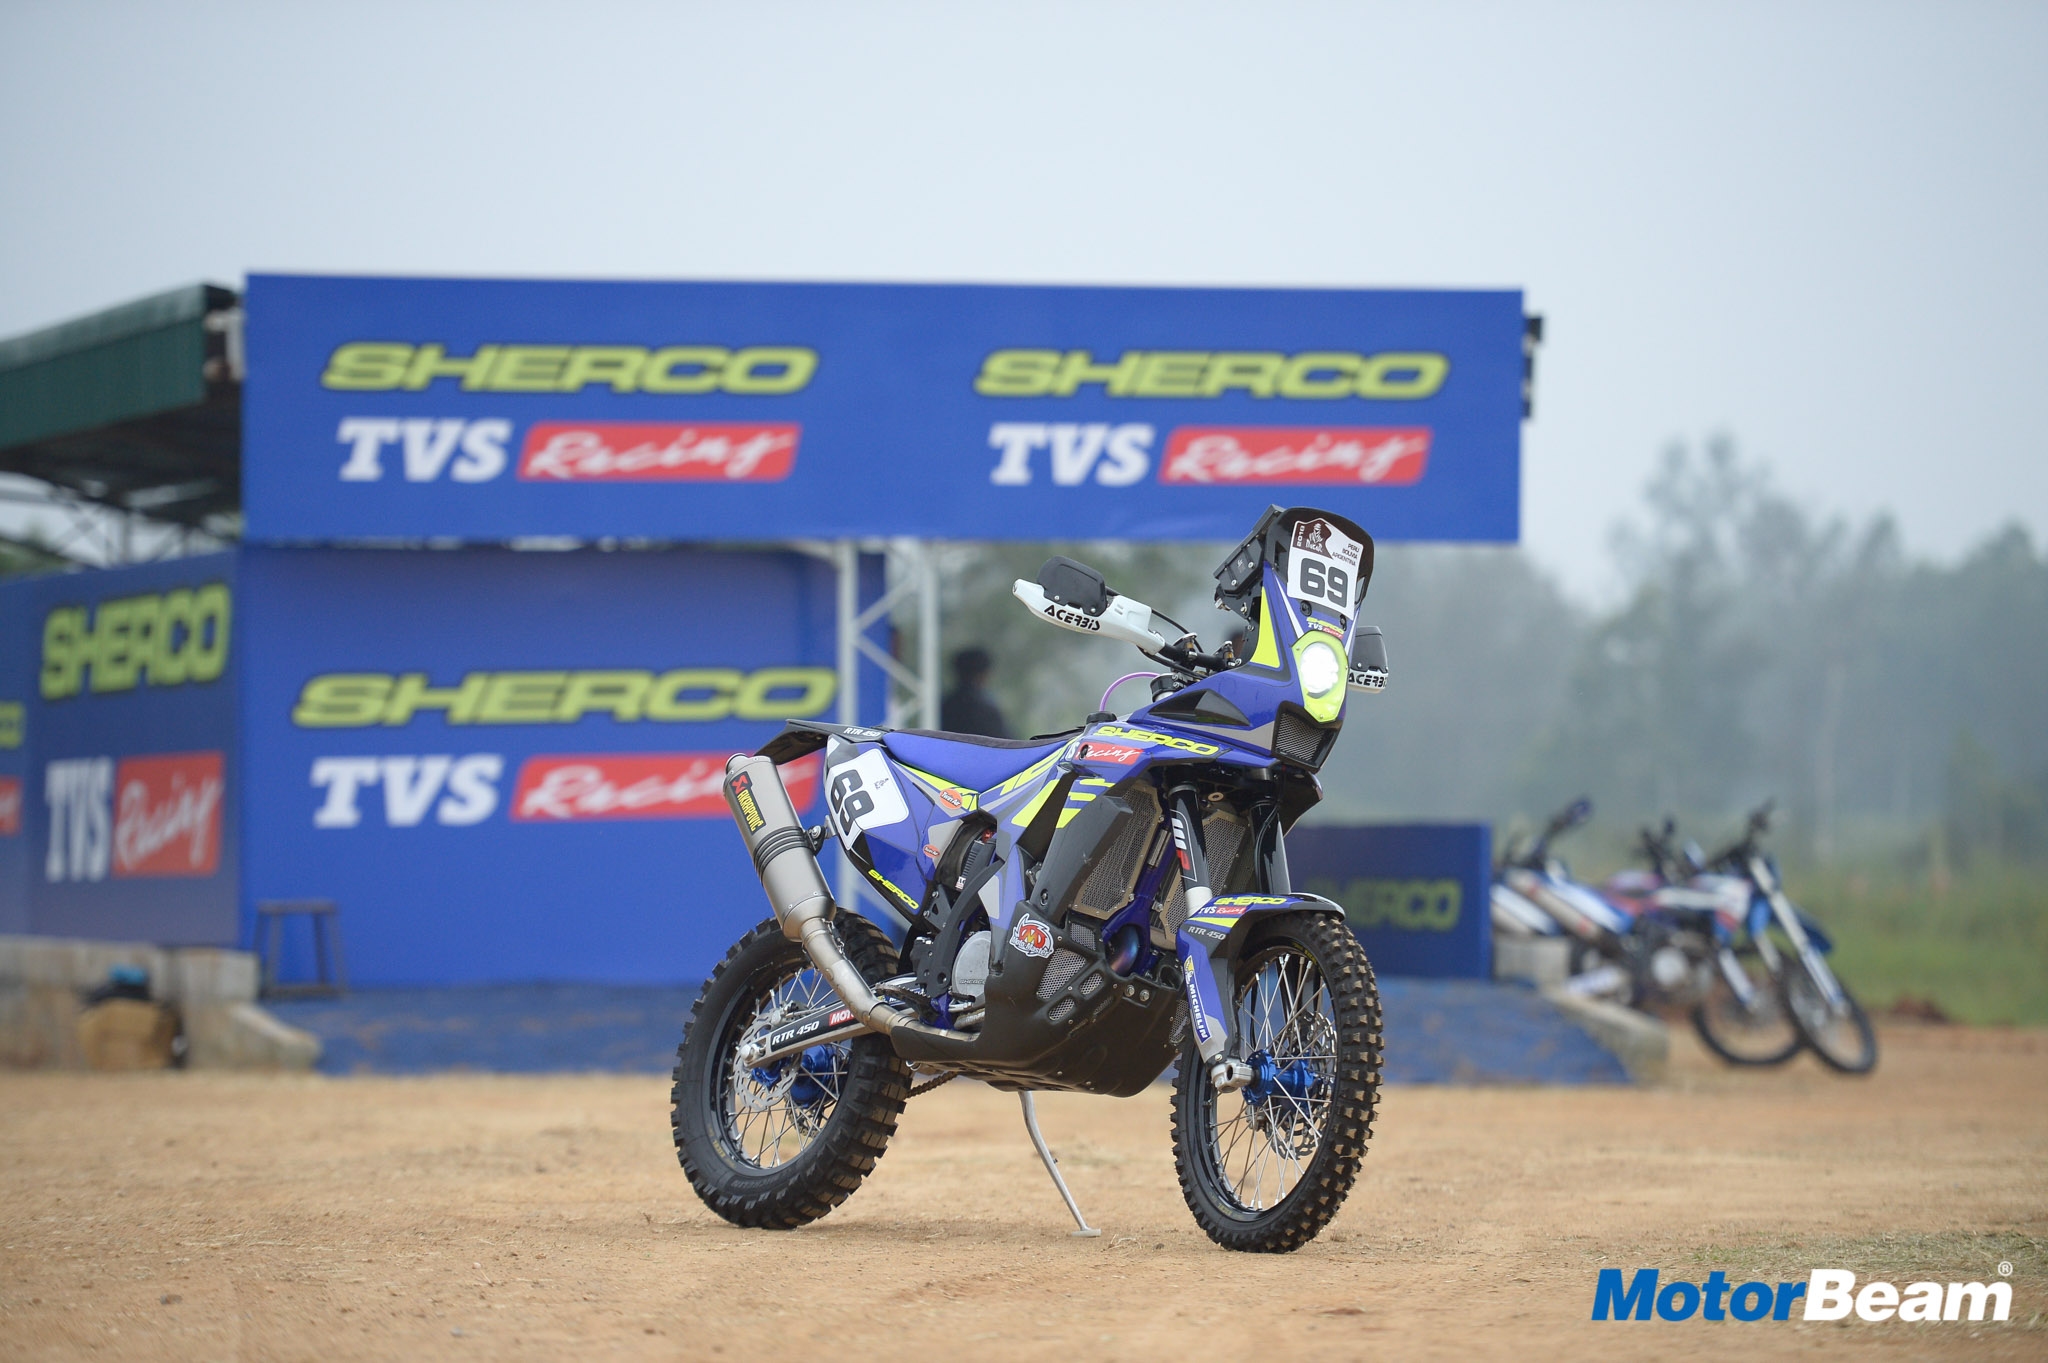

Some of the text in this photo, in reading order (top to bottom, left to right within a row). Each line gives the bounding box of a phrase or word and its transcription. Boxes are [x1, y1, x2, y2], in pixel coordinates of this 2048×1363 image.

[321, 341, 819, 394] SHERCO
[974, 349, 1449, 400] SHERCO
[336, 417, 796, 482] TVS Racing
[989, 422, 1428, 486] TVS Racing
[1300, 557, 1348, 608] 69
[40, 582, 231, 699] SHERCO
[292, 667, 839, 728] SHERCO
[843, 727, 863, 735] RTR
[1093, 725, 1219, 756] SHERCO
[311, 752, 503, 828] TVS
[831, 769, 875, 836] 69
[868, 869, 919, 909] SHERCO
[1214, 896, 1287, 906] SHERCO
[1188, 926, 1226, 940] RTR 450
[772, 1021, 820, 1046] RTR 450
[1189, 983, 1208, 1039] MICHELIN
